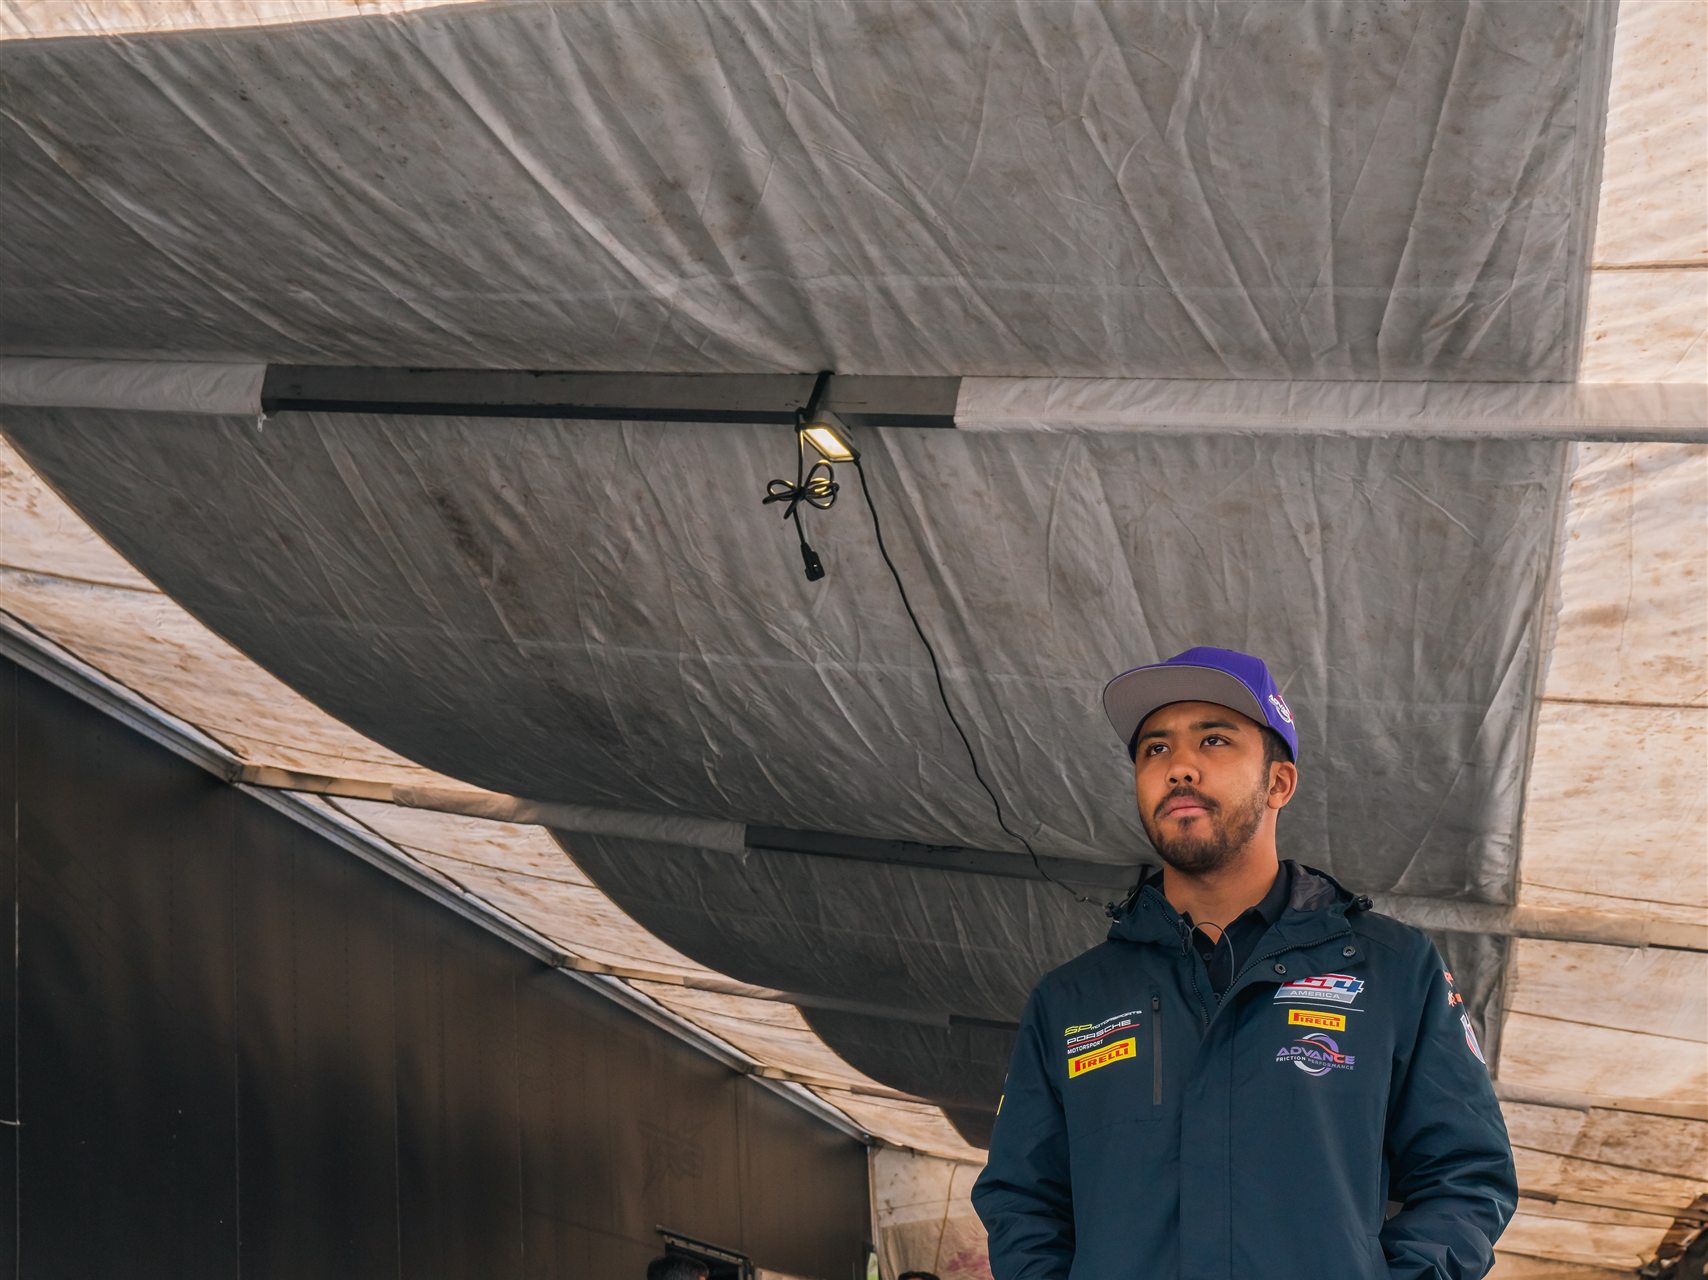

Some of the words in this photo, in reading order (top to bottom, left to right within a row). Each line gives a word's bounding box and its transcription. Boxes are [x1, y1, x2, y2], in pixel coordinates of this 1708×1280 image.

[1290, 990, 1340, 999] AMERICA
[1293, 1012, 1340, 1027] PIRELLI
[1064, 1024, 1092, 1037] SP
[1067, 1019, 1131, 1045] PORSCHE
[1067, 1039, 1104, 1055] MOTORSPORT
[1074, 1042, 1129, 1073] PIRELLI
[1275, 1055, 1306, 1063] FRICTION
[1307, 1058, 1354, 1071] PERFORMANCE
[1276, 1046, 1355, 1065] ADVANCE
